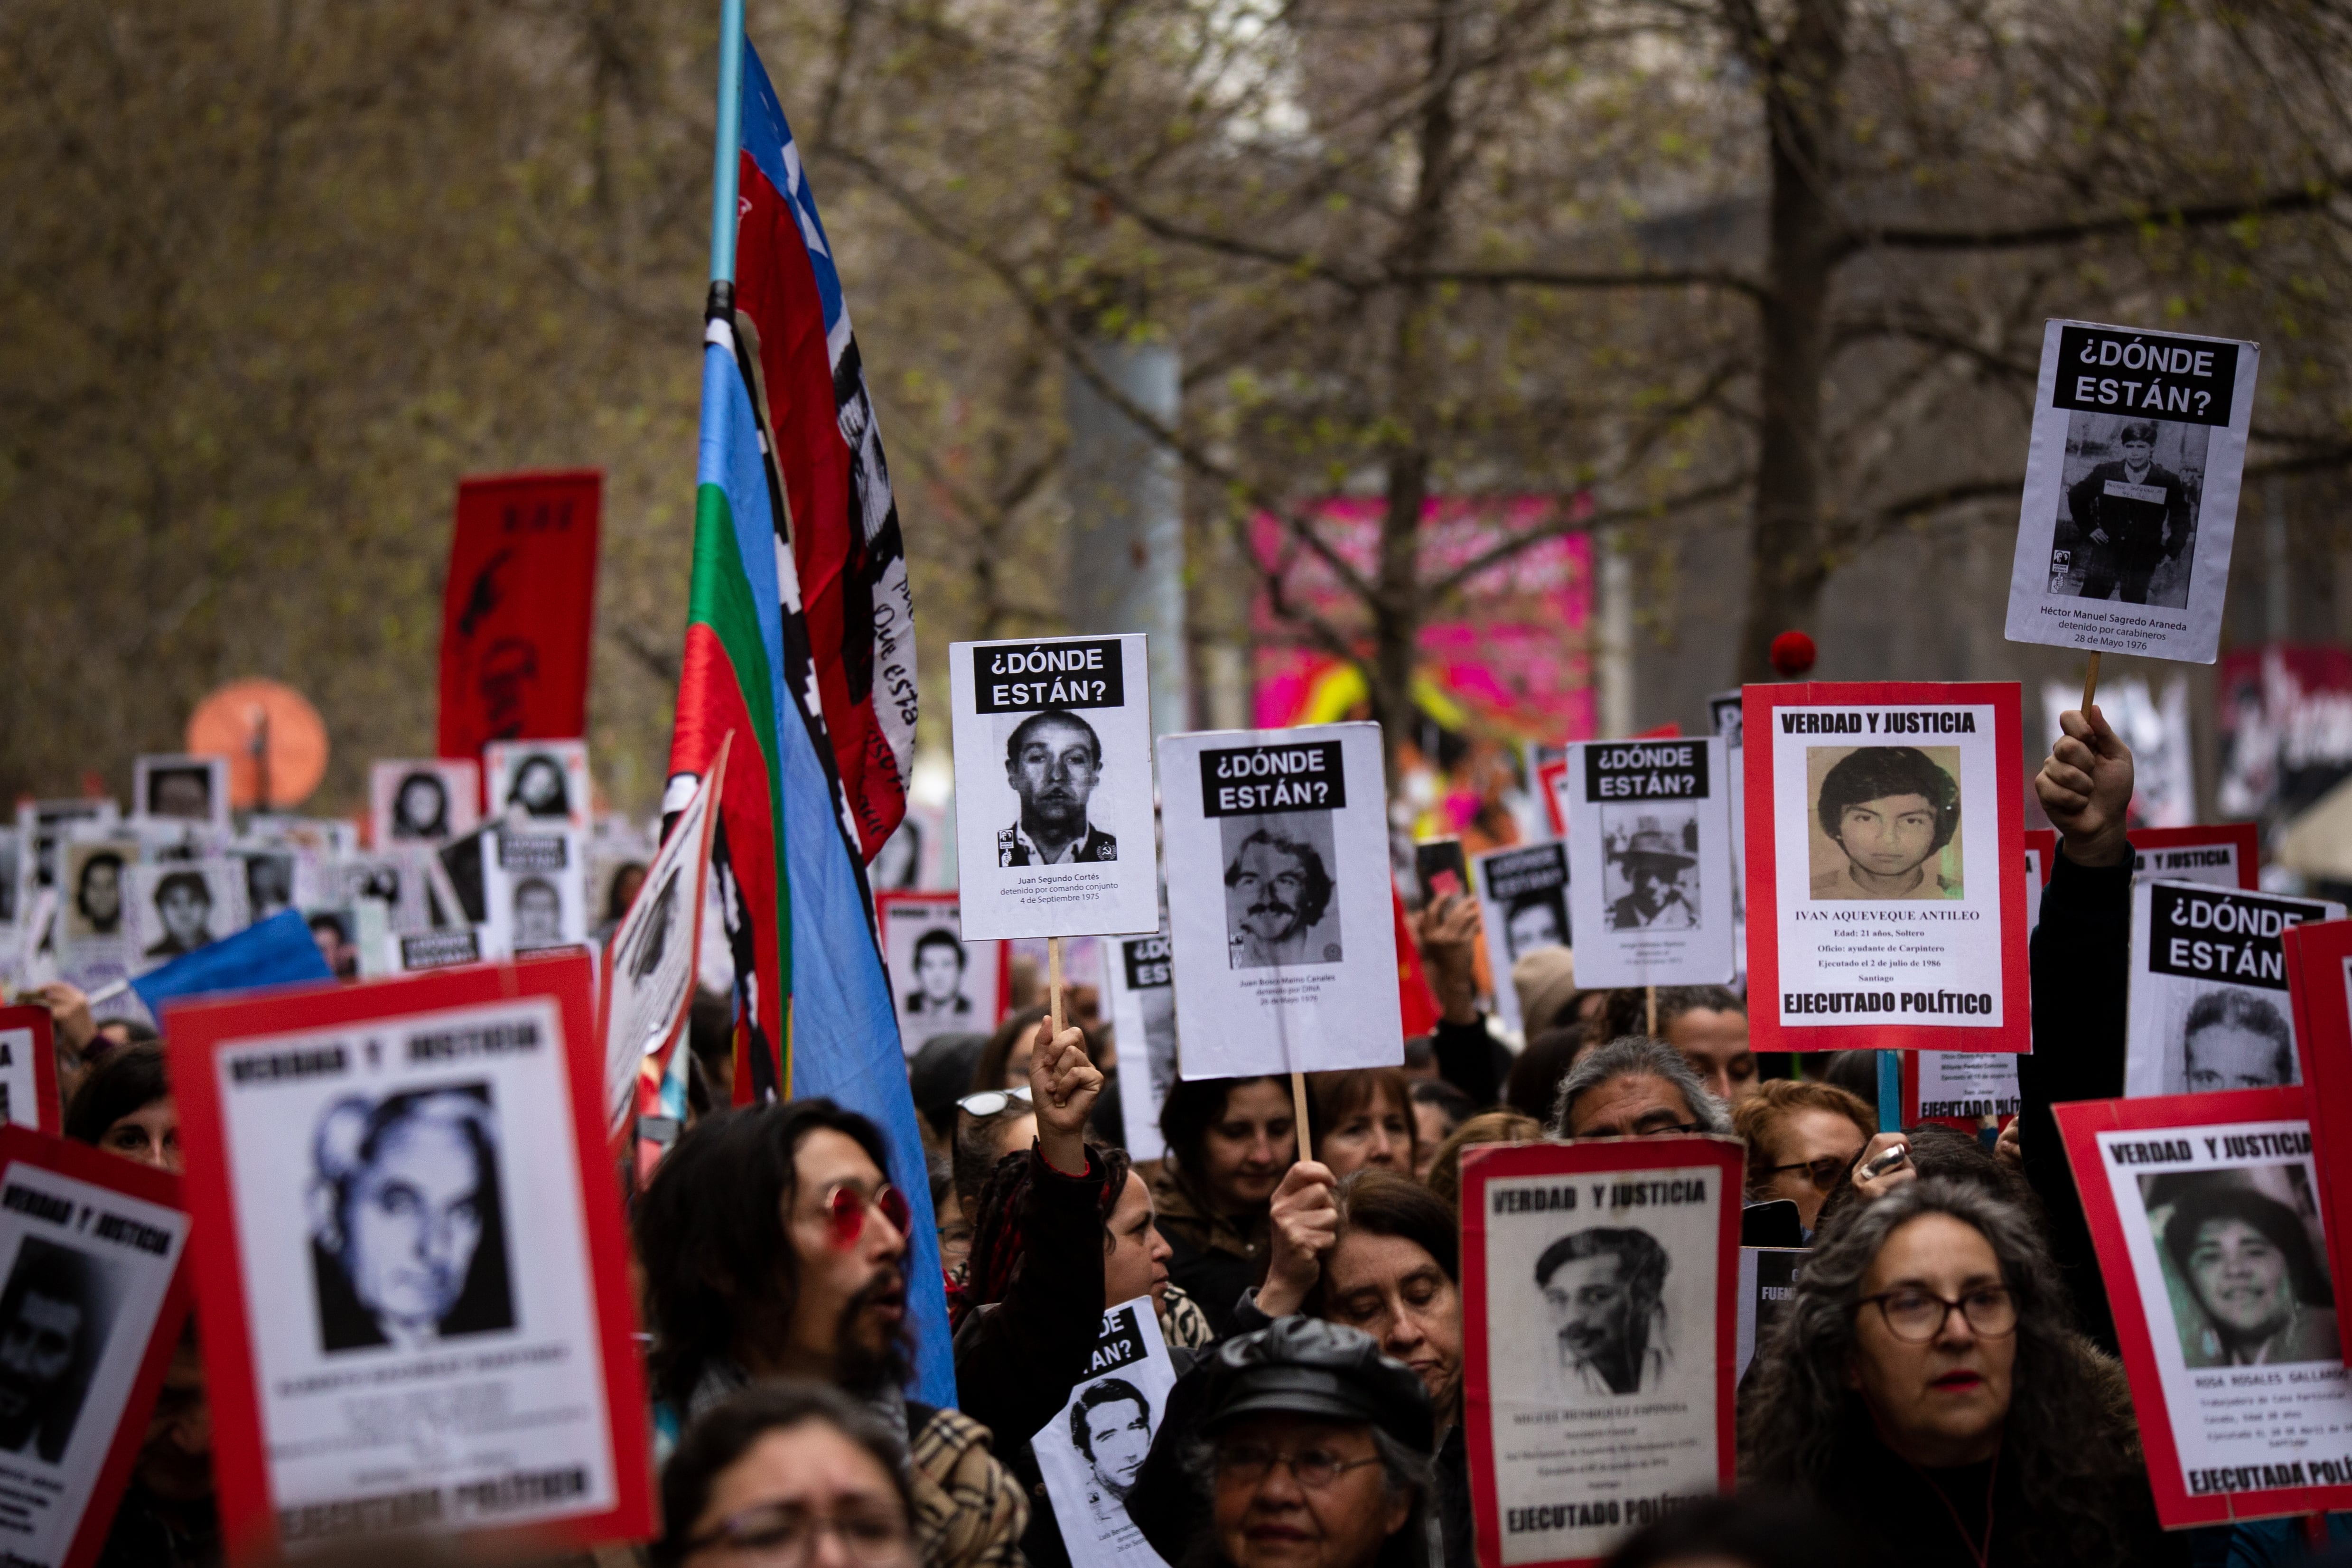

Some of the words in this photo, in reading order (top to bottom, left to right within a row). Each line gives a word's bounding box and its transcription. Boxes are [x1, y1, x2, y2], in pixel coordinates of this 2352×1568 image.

[2080, 337, 2214, 377] ¿DÓNDE
[2075, 376, 2211, 416] ESTÁN?
[2041, 606, 2071, 617] Héctor
[2073, 610, 2107, 621] Manuel
[2109, 615, 2146, 626] Sagredo
[2149, 619, 2186, 631] Araneda
[2059, 620, 2097, 632] detenido
[2100, 625, 2114, 635] por
[2117, 628, 2166, 640] carabineros
[2087, 635, 2098, 644] de
[2100, 637, 2123, 648] Mayo
[2127, 640, 2147, 650] 1976
[991, 646, 1103, 674] ¿DÓNDE
[993, 676, 1106, 705] ESTÁN?
[1782, 713, 1862, 733] VERDAD
[1867, 713, 1879, 733] Y
[1884, 712, 1976, 733] JUSTICIA
[1216, 748, 1325, 779] ¿DÓNDE
[1598, 744, 1693, 770] ¿DÓNDE
[1219, 778, 1329, 810] ESTÁN?
[1599, 770, 1696, 797] ESTÁN?
[2154, 854, 2164, 869] Y
[2165, 849, 2230, 869] JUSTICIA
[1000, 887, 1033, 895] detenido
[1086, 883, 1119, 893] conjunto
[1038, 875, 1073, 884] Segundo
[1074, 873, 1099, 881] Cortés
[1038, 895, 1080, 904] Septiembre
[1795, 911, 1828, 921] IVAN
[1832, 910, 1915, 922] AQUEVEQUE
[1920, 911, 1979, 921] ANTILEO
[1873, 929, 1893, 938] años,
[1848, 945, 1885, 953] ayudante
[1899, 945, 1944, 954] Carpintero
[2170, 941, 2282, 980] ESTÁN
[1819, 960, 1859, 969] Ejecutado
[1889, 960, 1908, 969] julio
[1858, 975, 1894, 983] Santiago
[1784, 992, 1895, 1014] EJECUTADO
[1901, 989, 1992, 1014] POLÍTICO
[1922, 1100, 1993, 1117] EJECUTADO
[2109, 1139, 2193, 1166] VERDAD
[2203, 1137, 2219, 1159] Y
[2223, 1132, 2312, 1160] JUSTICIA
[1493, 1186, 1577, 1213] VERDAD
[1592, 1185, 1605, 1208] Y
[1611, 1179, 1706, 1207] JUSTICIA
[2195, 1377, 2224, 1388] ROSA
[2189, 1462, 2306, 1494] EJECUTADA
[1508, 1498, 1619, 1533] EJECUTADO
